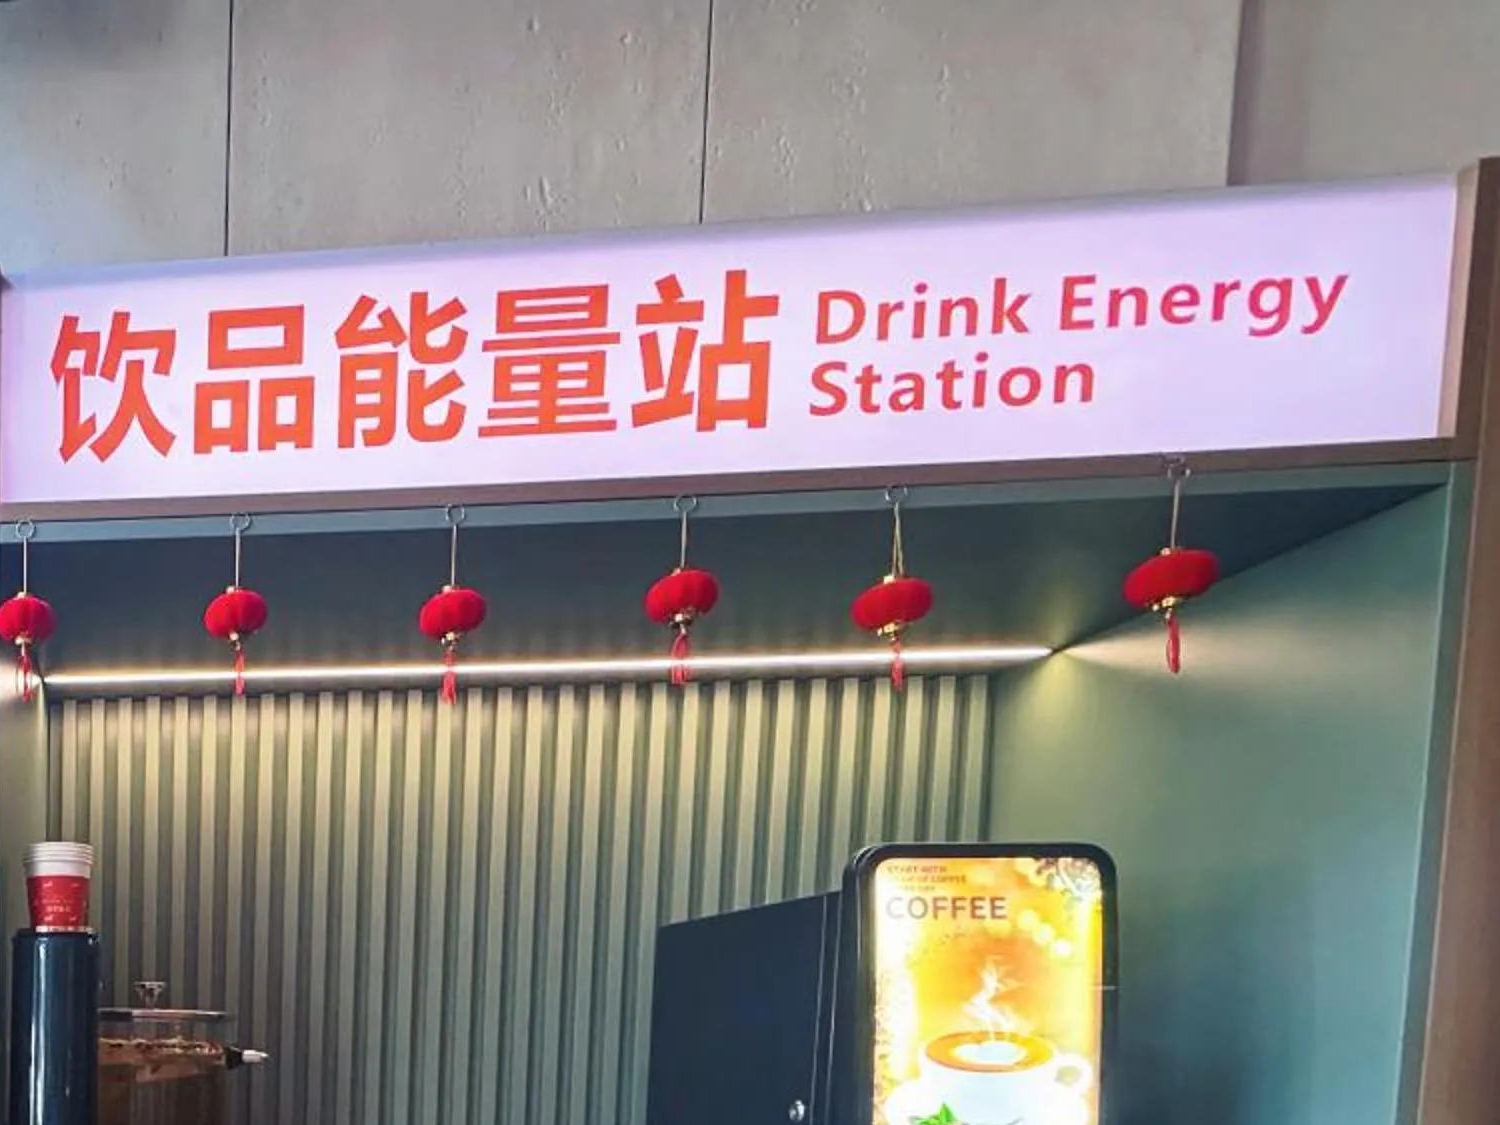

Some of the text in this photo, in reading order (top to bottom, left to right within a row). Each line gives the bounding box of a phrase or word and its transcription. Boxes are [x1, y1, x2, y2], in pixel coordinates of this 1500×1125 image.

[815, 274, 1350, 345] Drink Energy
[50, 269, 779, 463] 饮品能量站
[809, 351, 1096, 417] Station
[886, 896, 1008, 920] COFFEE
